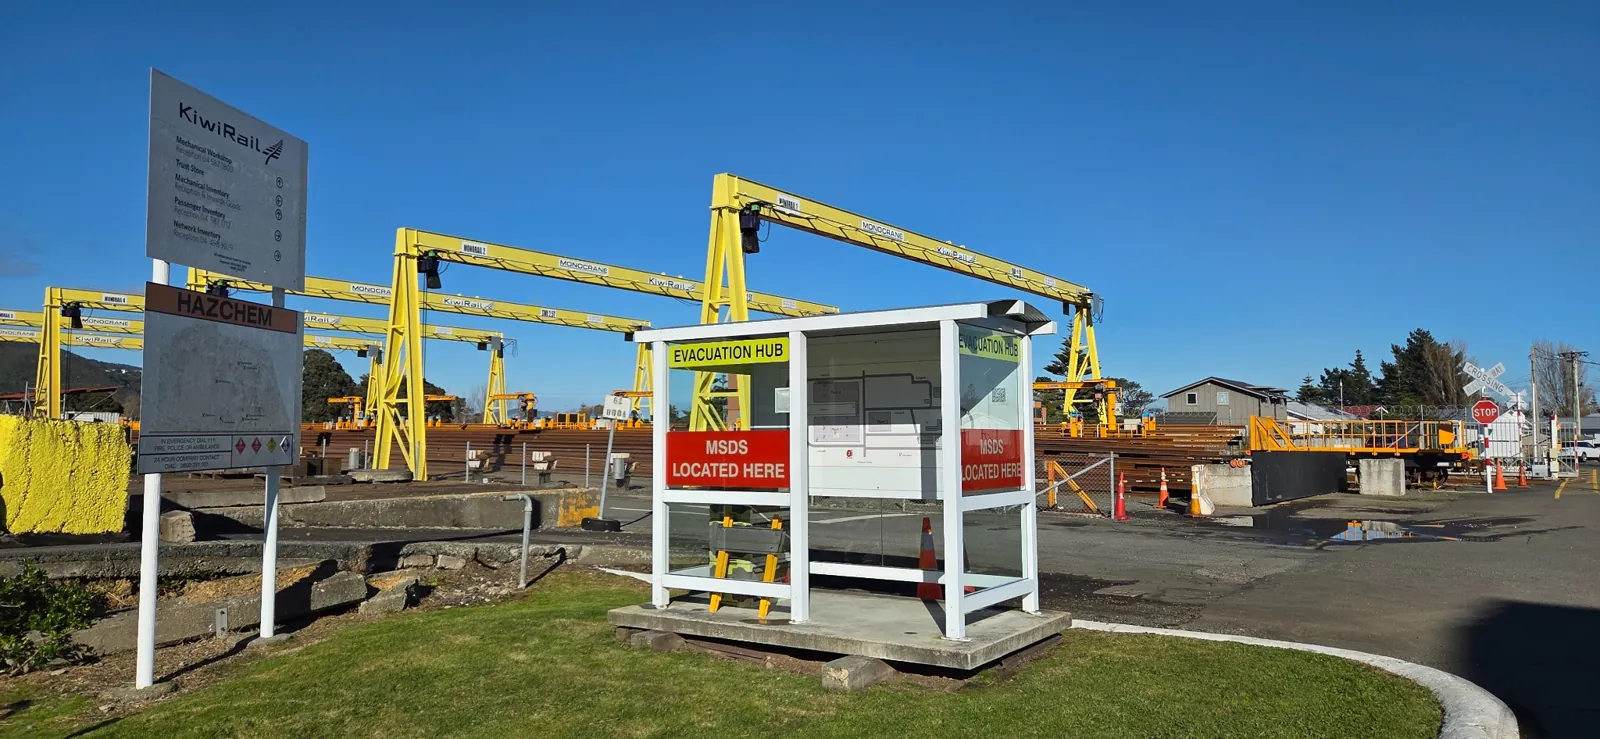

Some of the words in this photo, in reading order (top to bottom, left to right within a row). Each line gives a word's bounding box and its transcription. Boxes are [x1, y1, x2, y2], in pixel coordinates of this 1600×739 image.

[179, 102, 261, 153] KiwiRail
[176, 135, 206, 154] Mechanical
[207, 148, 233, 165] Workshop
[175, 158, 190, 171] Trust
[190, 164, 205, 176] Store
[174, 173, 205, 189] Mechanical
[205, 184, 230, 200] Inventory
[174, 196, 201, 211] Passenger
[202, 205, 225, 220] Inventory
[173, 220, 197, 233] Network
[197, 226, 222, 242] Inventory
[862, 221, 903, 240] MONOCRANE
[463, 244, 483, 254] MONORAIL
[560, 260, 608, 274] MONOCRANE
[649, 277, 685, 290] KiwiRail
[177, 292, 273, 327] HAZCHEM
[444, 297, 481, 308] KiwiRail
[82, 318, 129, 326] MONOCRANE
[674, 346, 752, 363] EVACUATION
[755, 343, 784, 358] HUB
[959, 333, 1003, 355] EVACUATION
[1004, 344, 1019, 357] HUB
[1467, 364, 1504, 393] CROSSING
[1474, 408, 1496, 417] STOP
[706, 440, 749, 455] MSDS
[980, 439, 1004, 455] MSDS
[673, 463, 739, 477] LOCATED
[743, 463, 785, 478] HERE
[962, 464, 999, 481] LOCATED
[1001, 462, 1022, 478] HERE
